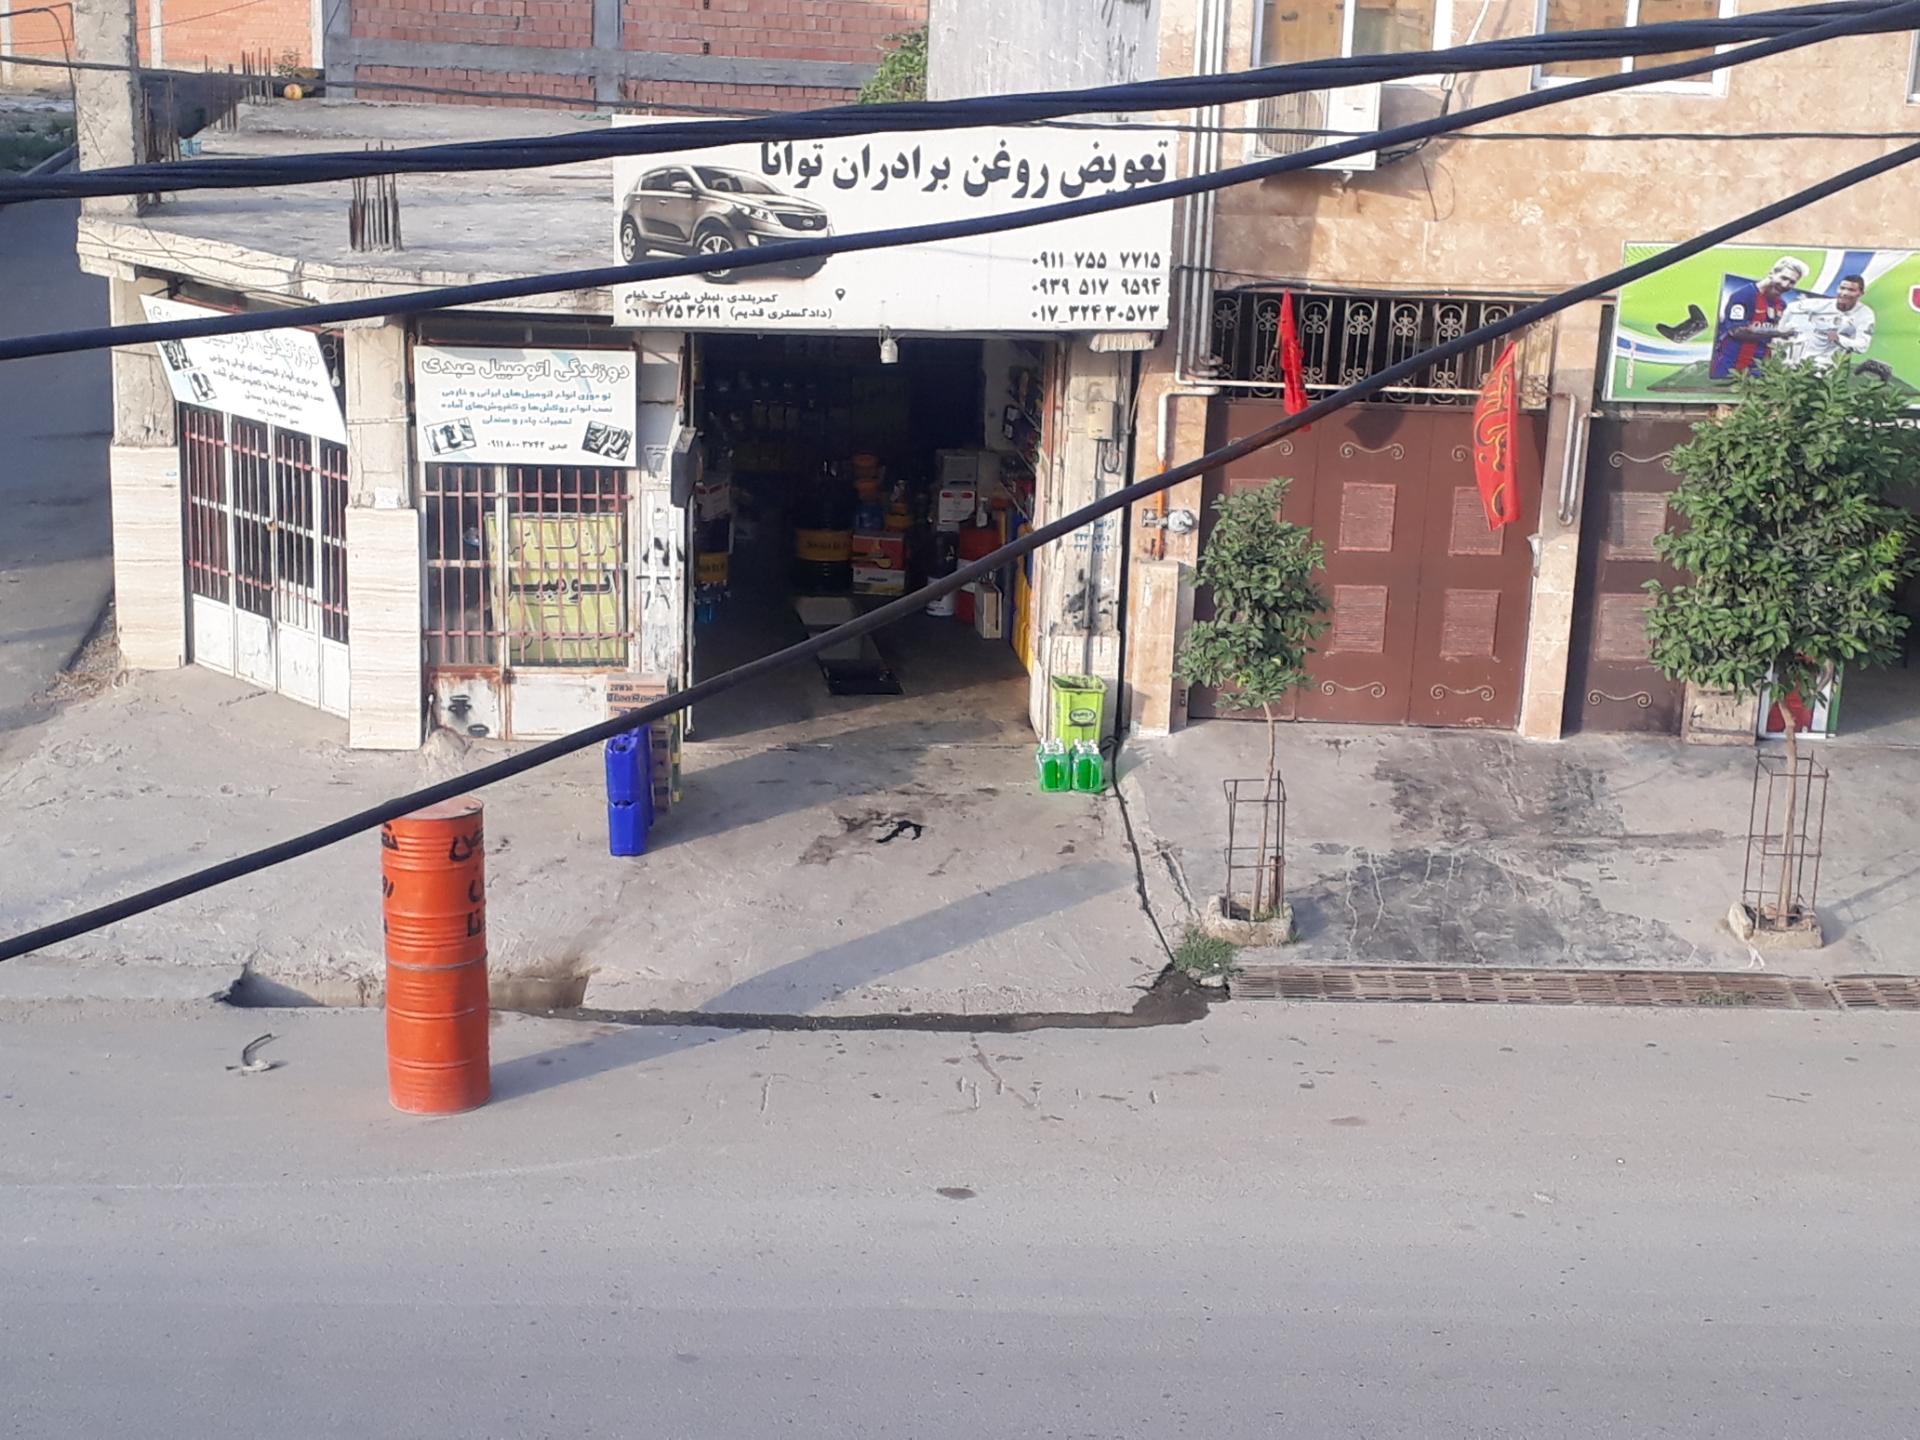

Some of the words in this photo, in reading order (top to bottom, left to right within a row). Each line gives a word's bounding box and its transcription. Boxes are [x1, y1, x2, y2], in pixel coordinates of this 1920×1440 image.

[760, 141, 824, 189] توانا
[833, 143, 951, 192] برادران
[963, 139, 1049, 198] روغن
[1060, 140, 1169, 198] تعویض
[1032, 251, 1064, 269] ۰۹۱۱
[1074, 251, 1107, 269] ۷۵۵
[1120, 251, 1161, 269] ۷۷۱۵
[624, 290, 649, 303] خیام
[1032, 278, 1070, 295] ۰۹۳۹
[1079, 278, 1109, 295] ۵۱۷
[1121, 277, 1161, 295] ۹۵۹۴
[421, 357, 476, 379] عبدی
[479, 359, 551, 381] اتومبیل
[554, 357, 630, 383] دوزندگی
